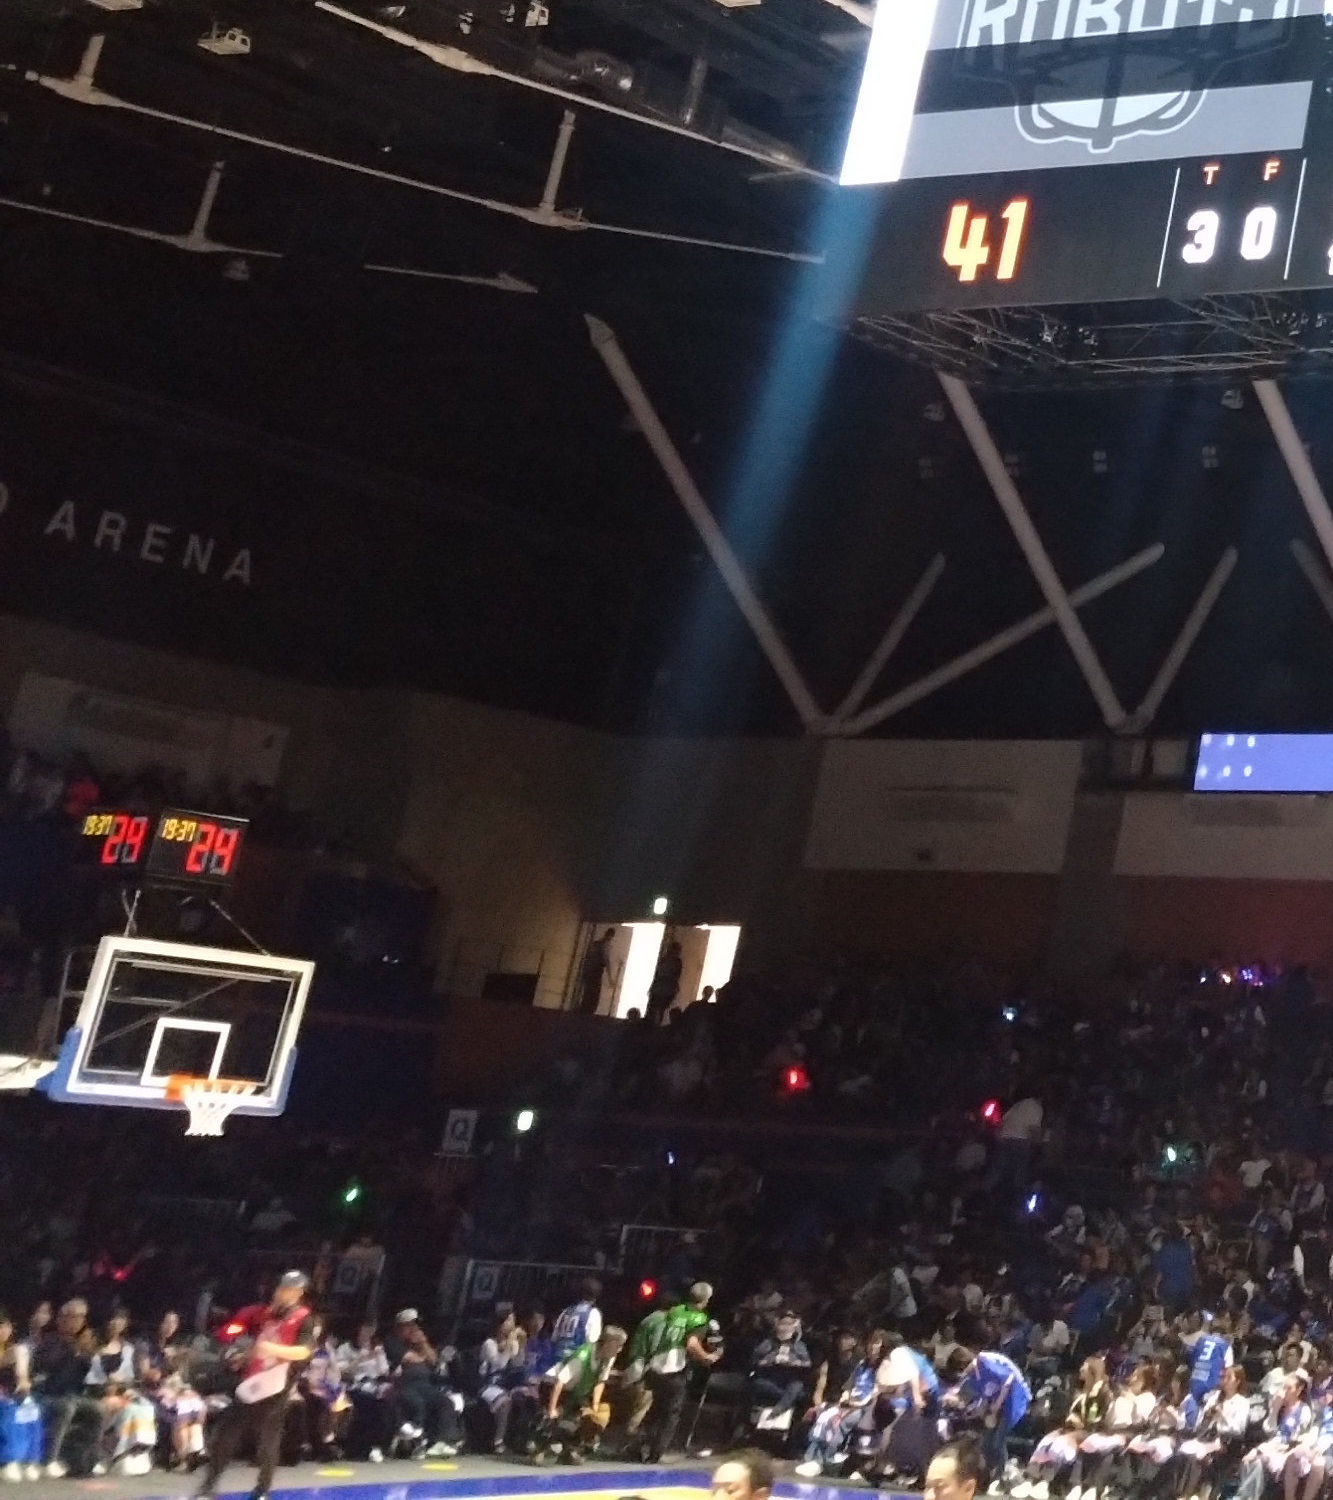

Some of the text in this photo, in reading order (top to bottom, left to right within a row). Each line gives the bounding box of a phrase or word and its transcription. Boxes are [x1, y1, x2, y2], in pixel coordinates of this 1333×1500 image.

[1203, 160, 1280, 185] T F
[942, 198, 1028, 282] 41
[1181, 205, 1278, 264] 3 0
[44, 500, 253, 586] ARENA
[101, 813, 148, 864] 24
[161, 818, 240, 876] 19:37 24
